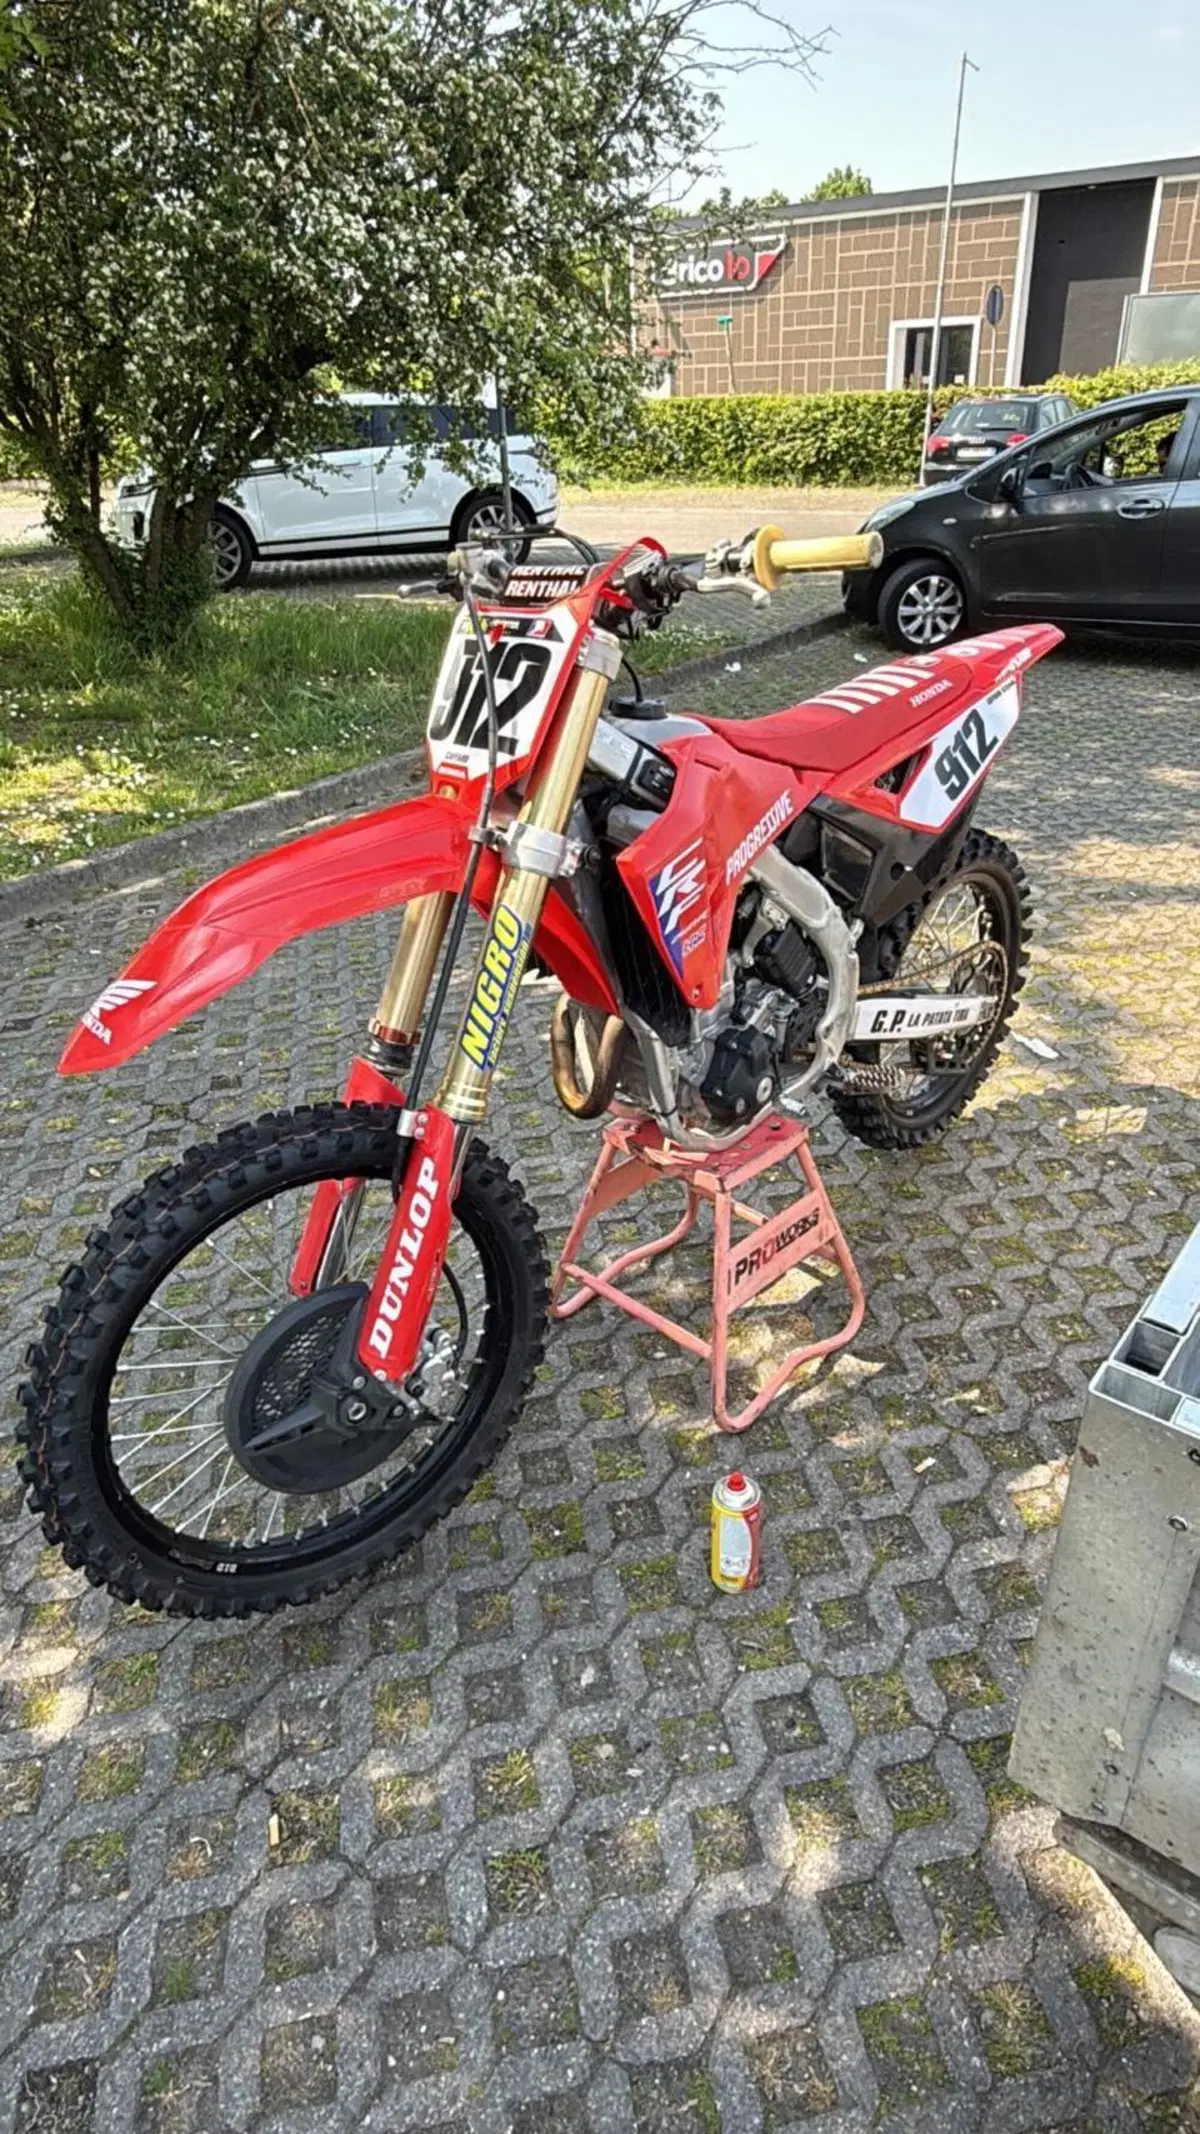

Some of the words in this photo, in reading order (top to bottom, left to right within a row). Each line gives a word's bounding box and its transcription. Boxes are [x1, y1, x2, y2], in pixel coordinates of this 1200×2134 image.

[429, 639, 552, 756] 912
[909, 679, 953, 708] HONDA
[934, 708, 999, 802] 912
[460, 904, 523, 1070] NIGRO
[870, 1009, 907, 1033] G.P.
[907, 1012, 921, 1027] LA
[369, 1157, 440, 1360] DUNLOP
